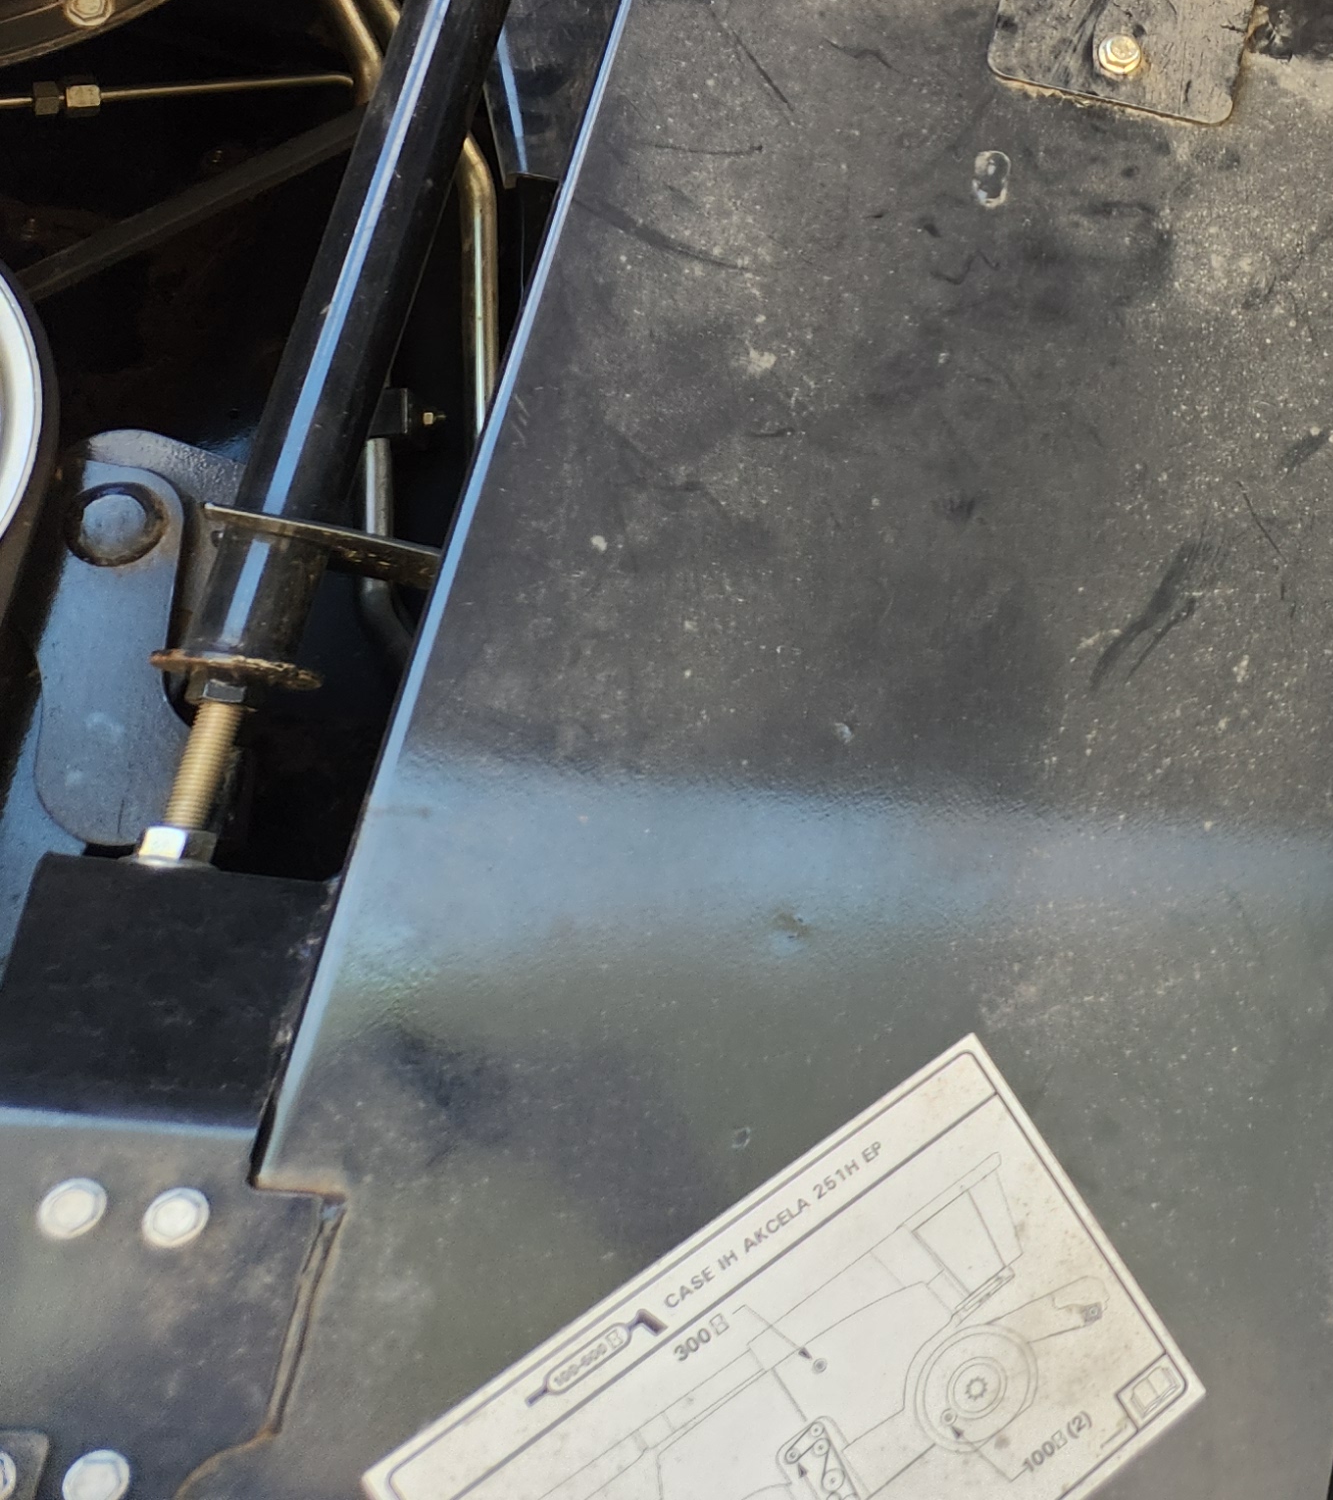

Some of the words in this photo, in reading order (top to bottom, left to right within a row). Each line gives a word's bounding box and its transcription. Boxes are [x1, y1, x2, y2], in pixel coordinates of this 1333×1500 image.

[664, 1266, 715, 1308] CASE
[717, 1249, 739, 1271] IH
[743, 1198, 811, 1253] AKCELA
[812, 1159, 860, 1200] 251H
[862, 1141, 883, 1164] EP
[674, 1327, 711, 1362] 300
[1022, 1440, 1055, 1472] 100
